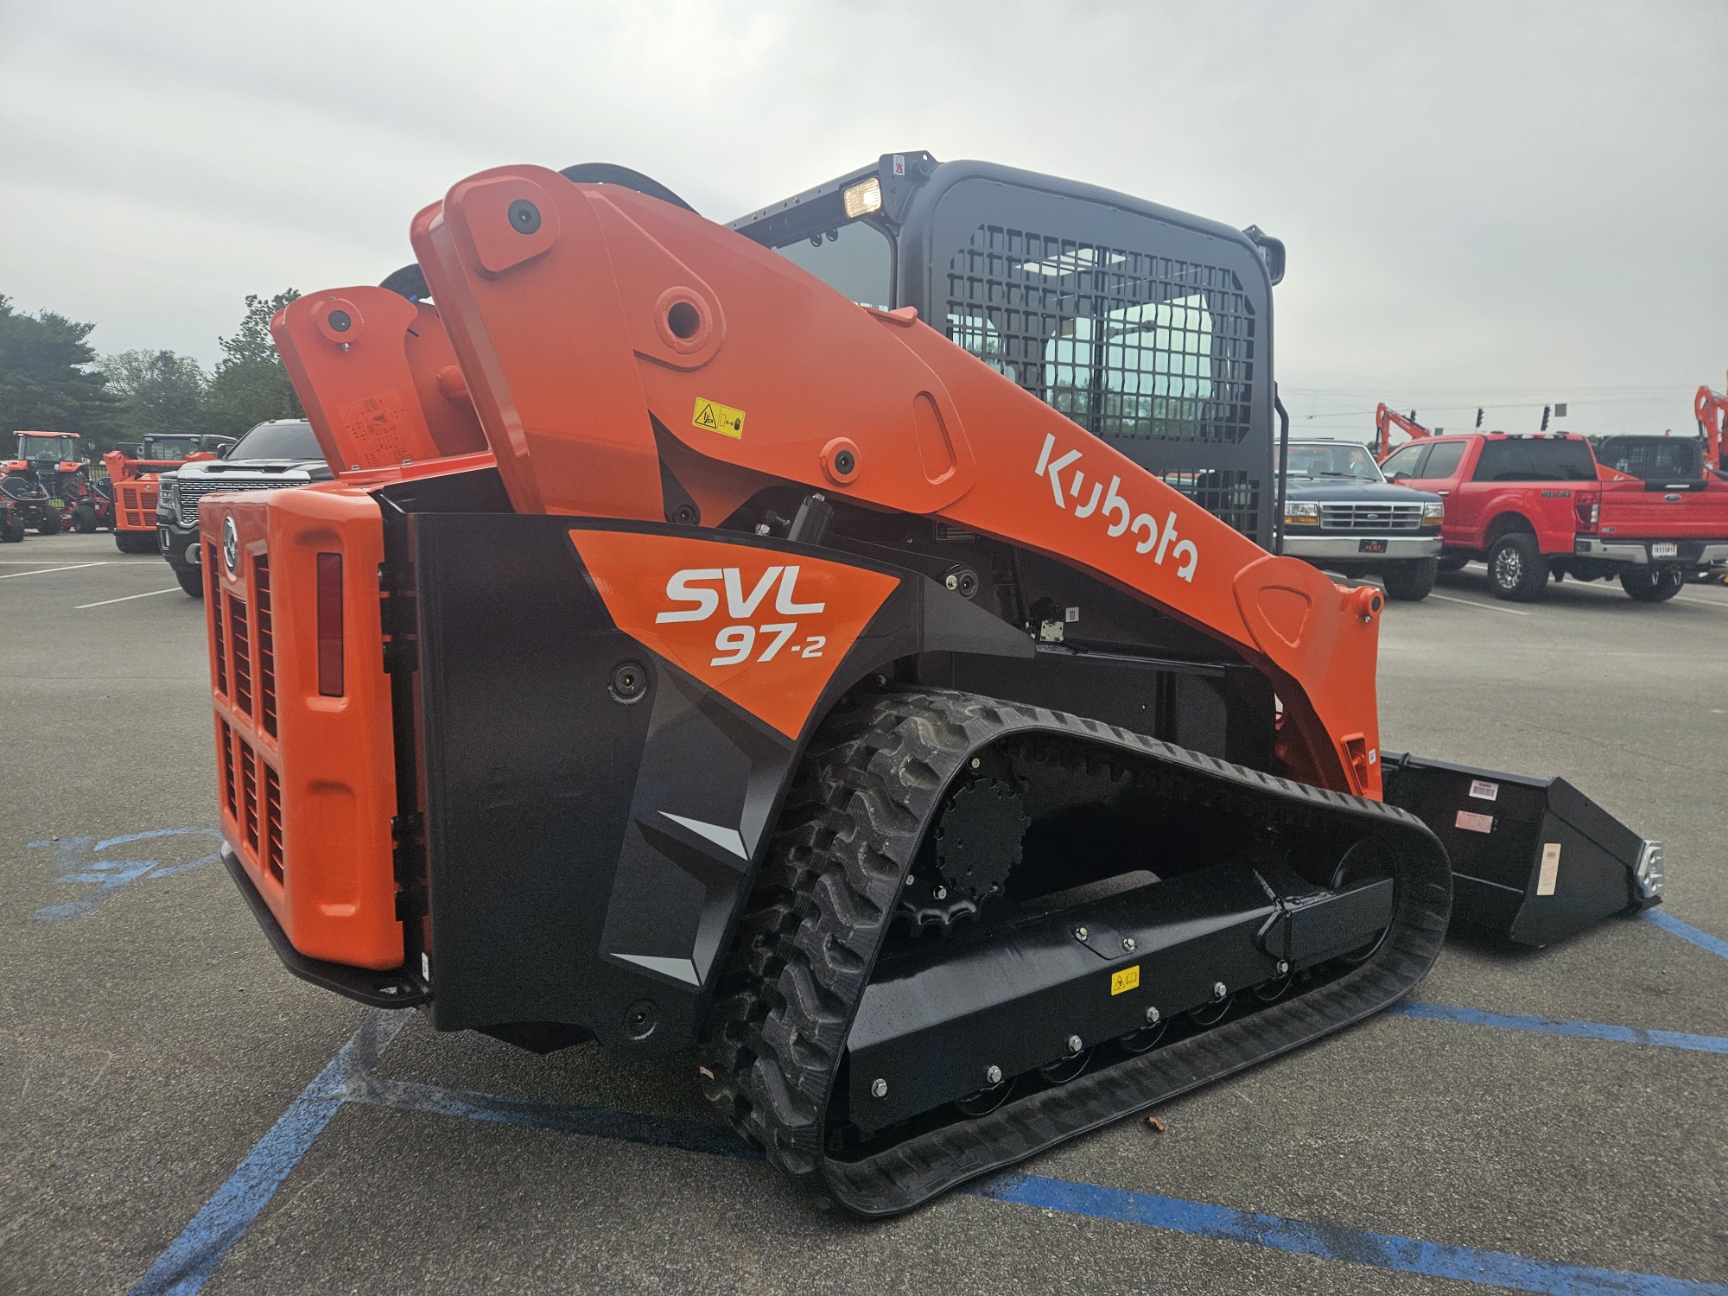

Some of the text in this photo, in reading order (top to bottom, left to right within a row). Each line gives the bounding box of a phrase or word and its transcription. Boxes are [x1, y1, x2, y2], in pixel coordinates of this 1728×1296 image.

[1034, 432, 1199, 583] Kubota
[654, 565, 825, 624] SVL
[709, 622, 826, 667] 97-2
